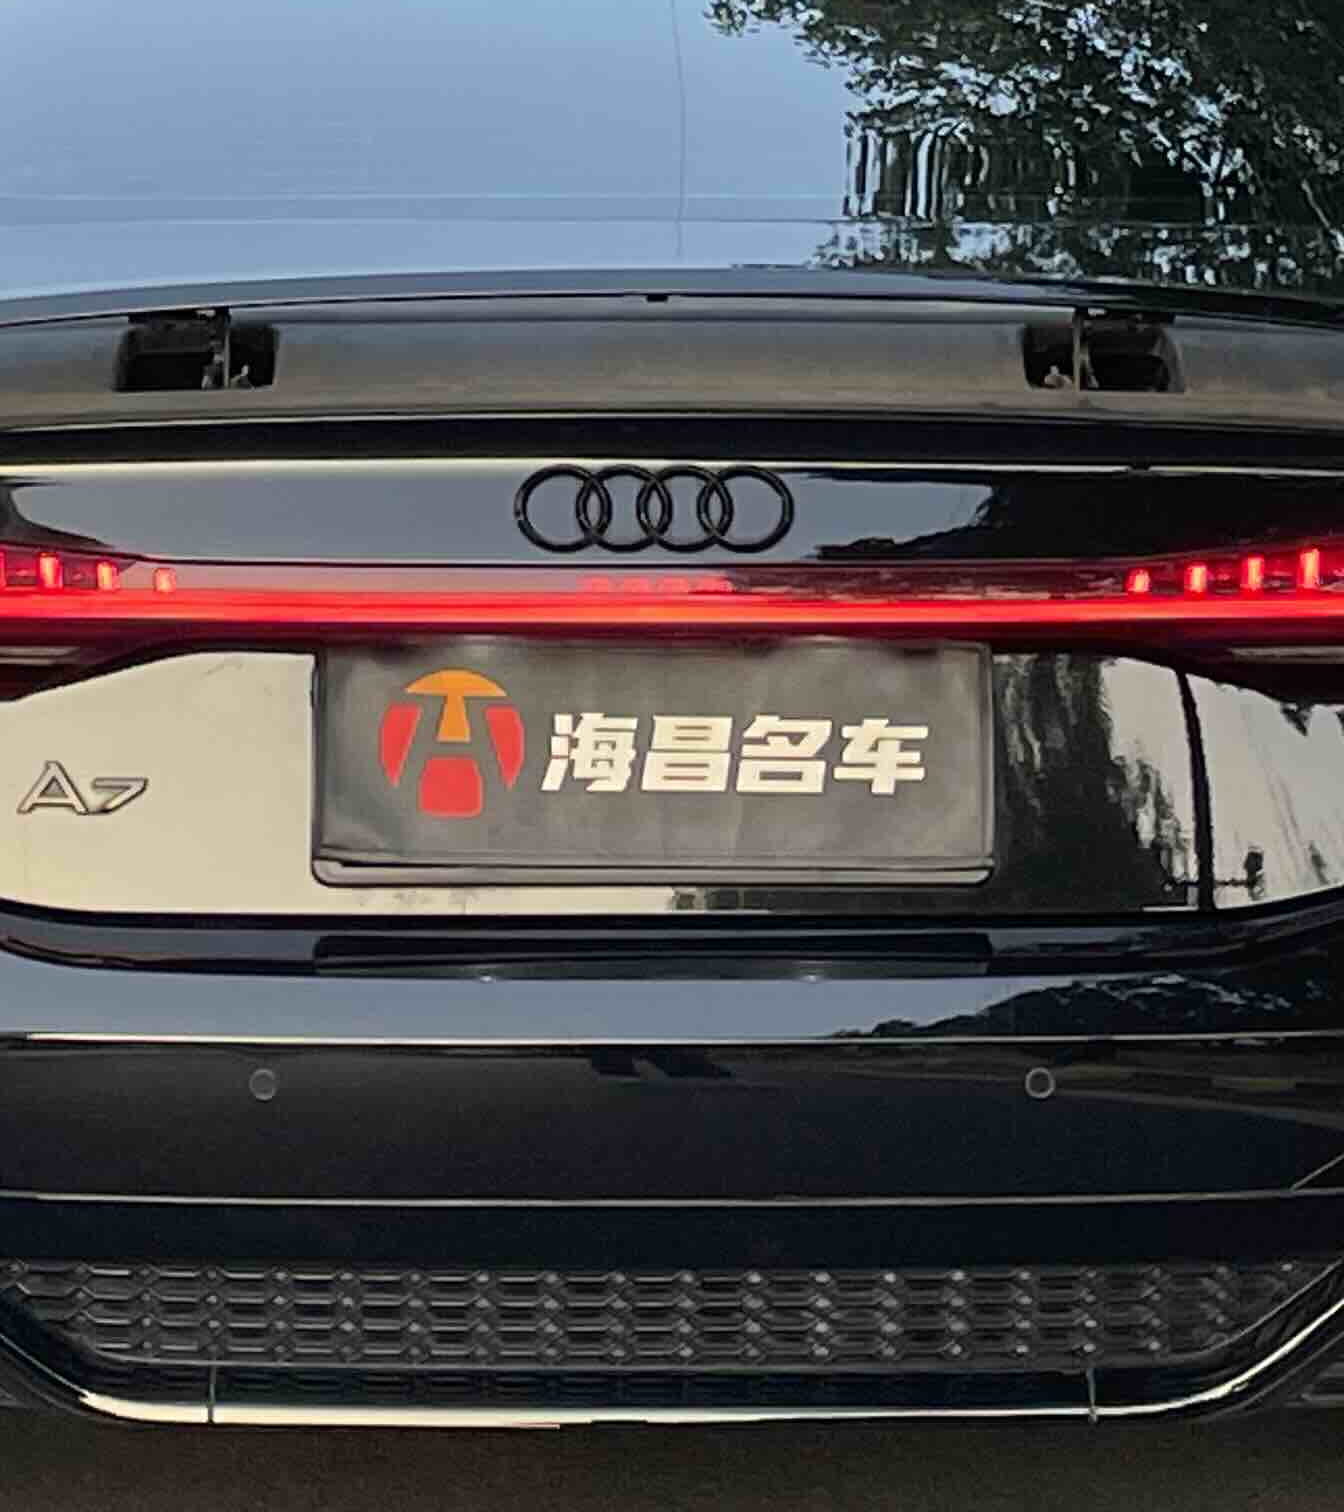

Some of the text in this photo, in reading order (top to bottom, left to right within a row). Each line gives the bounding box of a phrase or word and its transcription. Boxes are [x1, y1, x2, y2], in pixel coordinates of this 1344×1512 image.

[16, 760, 149, 816] A7
[541, 712, 930, 795] 海昌名车
